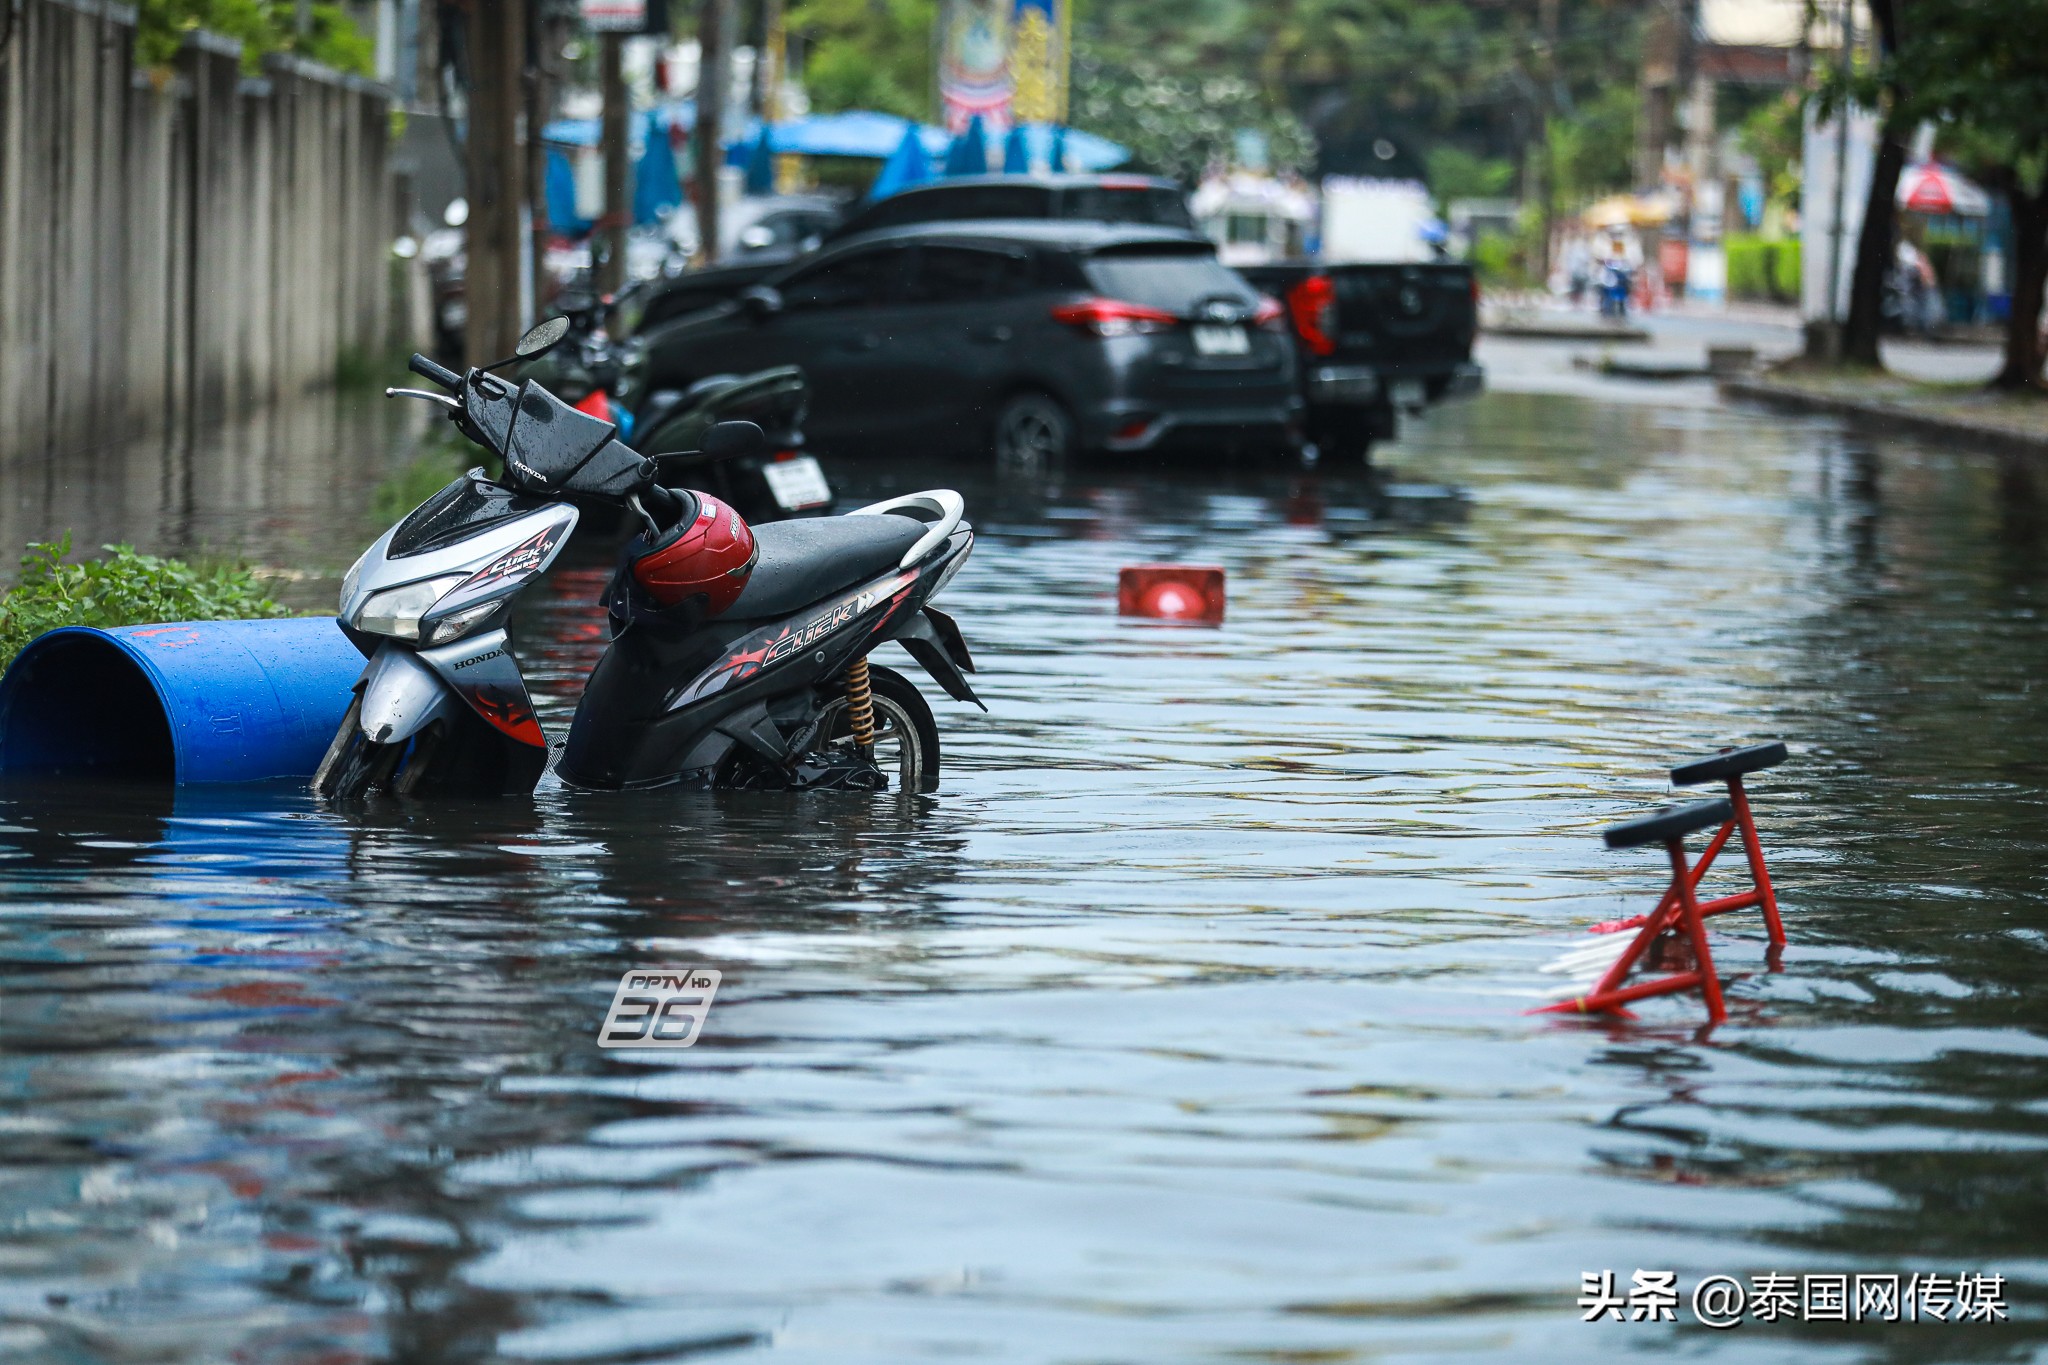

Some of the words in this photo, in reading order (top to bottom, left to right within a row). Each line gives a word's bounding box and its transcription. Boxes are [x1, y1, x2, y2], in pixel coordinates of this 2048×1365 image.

[514, 460, 548, 483] HONDA
[488, 547, 541, 575] CLICK
[762, 604, 853, 668] CLICK
[453, 649, 505, 671] HONDA
